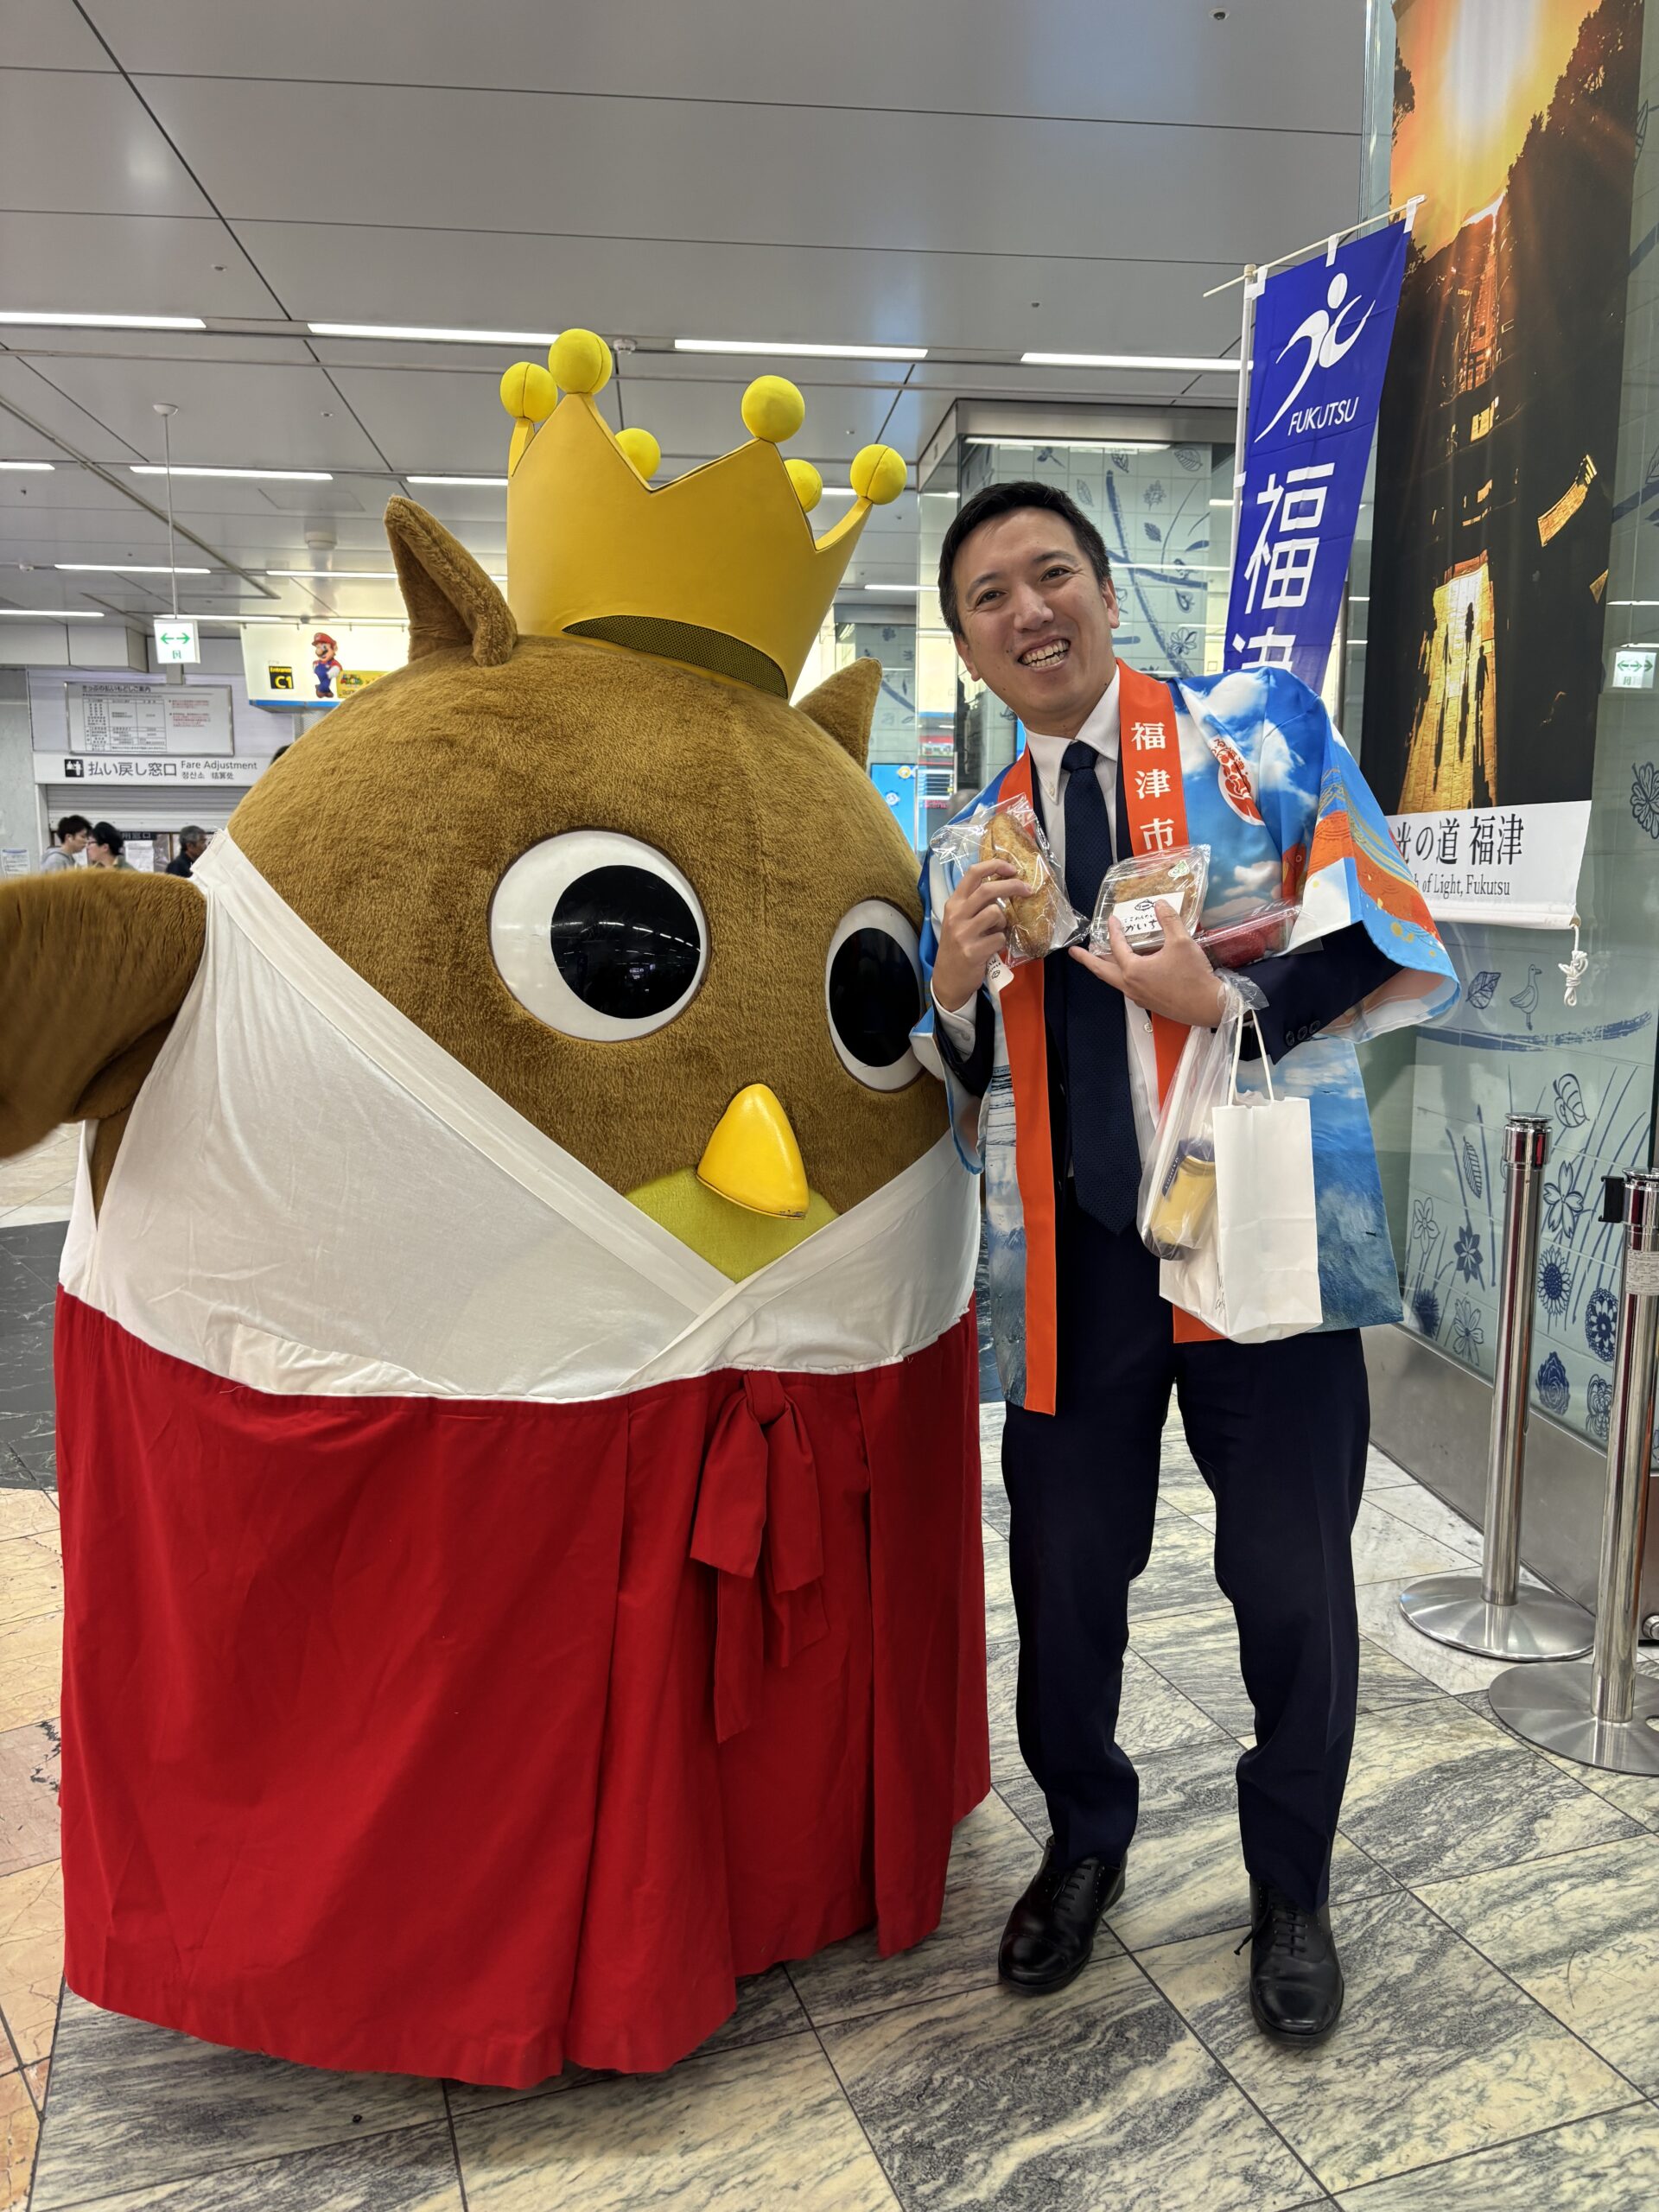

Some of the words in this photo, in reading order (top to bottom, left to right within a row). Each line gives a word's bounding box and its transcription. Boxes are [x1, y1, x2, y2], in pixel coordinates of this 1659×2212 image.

[1287, 397, 1359, 436] FUKUTSU
[275, 676, 292, 689] C1
[88, 761, 177, 777] 払い戻し窓口
[181, 760, 201, 769] Fare
[204, 760, 257, 771] Adjustment
[1131, 722, 1174, 851] 福津市
[1469, 813, 1524, 865] 福津
[1422, 873, 1433, 893] of
[1433, 874, 1463, 899] Light,
[1465, 874, 1510, 895] Fukutsu
